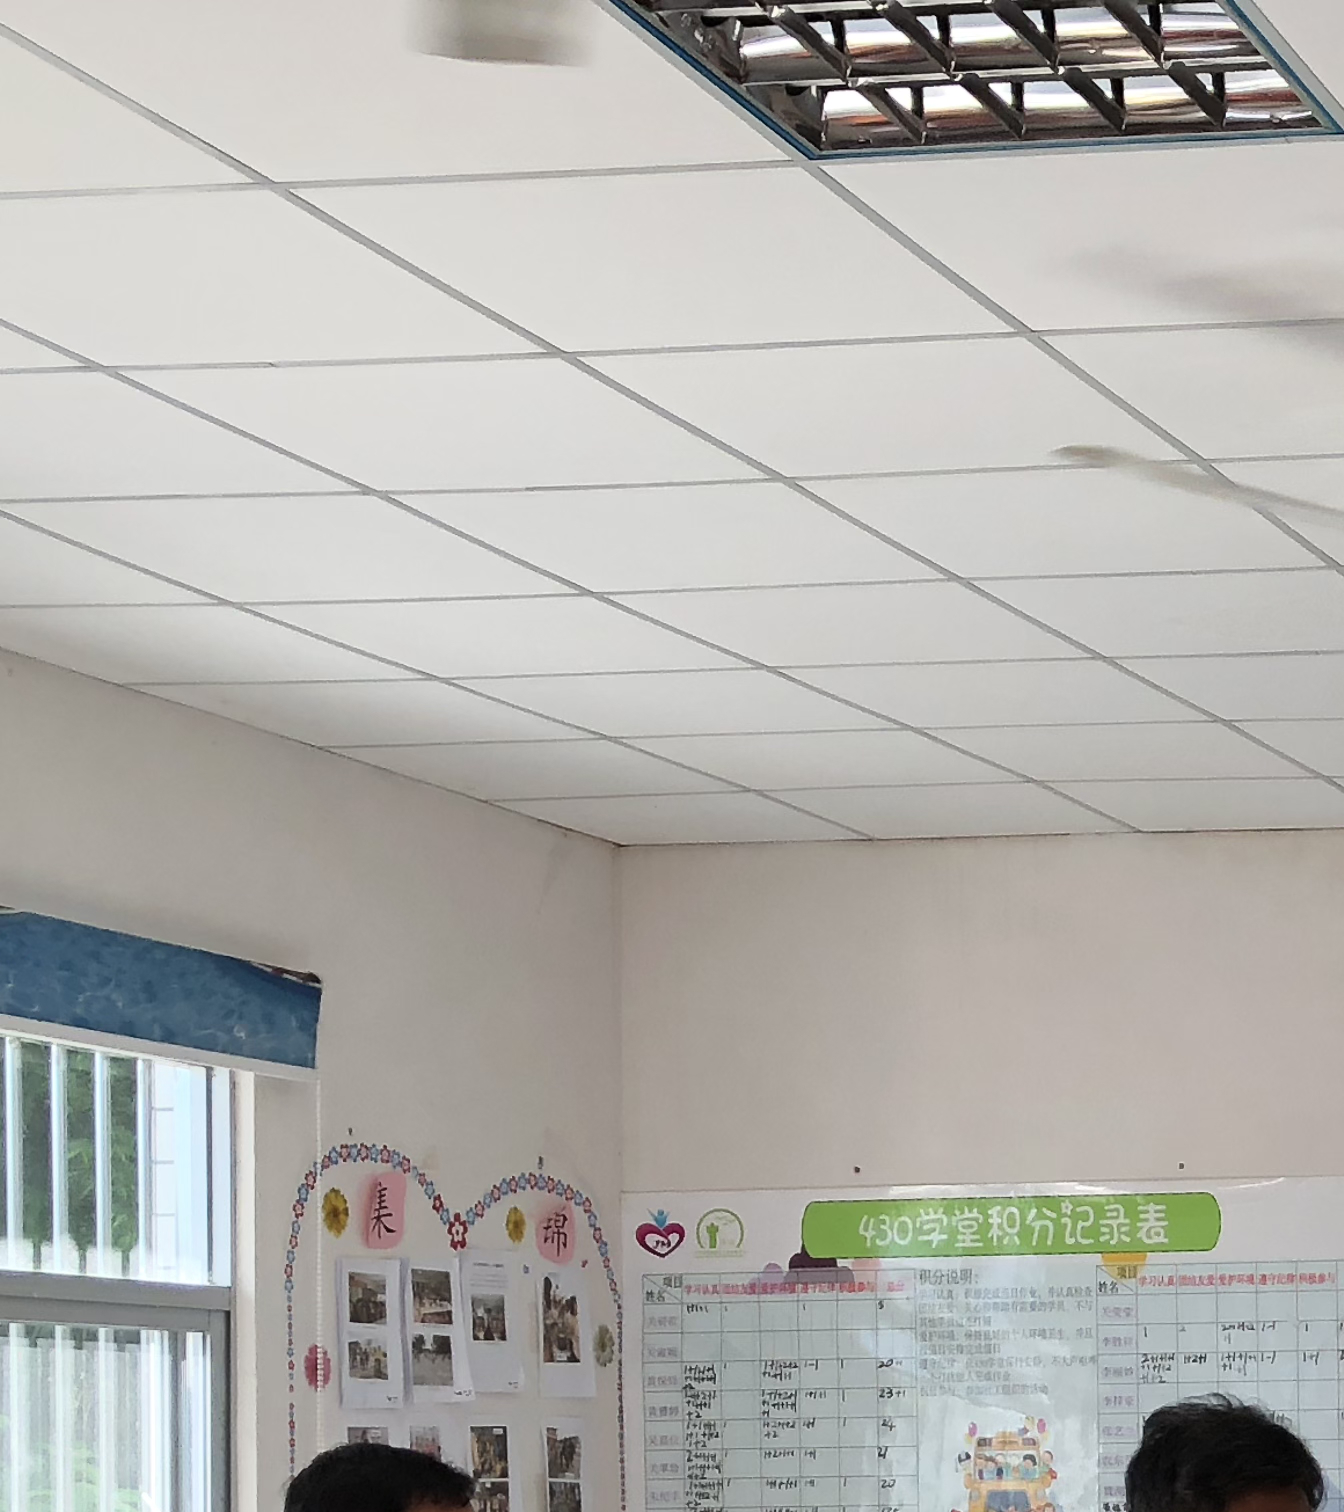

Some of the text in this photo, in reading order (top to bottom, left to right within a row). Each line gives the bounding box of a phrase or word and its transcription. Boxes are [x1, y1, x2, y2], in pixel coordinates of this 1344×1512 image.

[859, 1203, 1169, 1248] 430学堂积分记录表
[1098, 1281, 1119, 1293] 姓名
